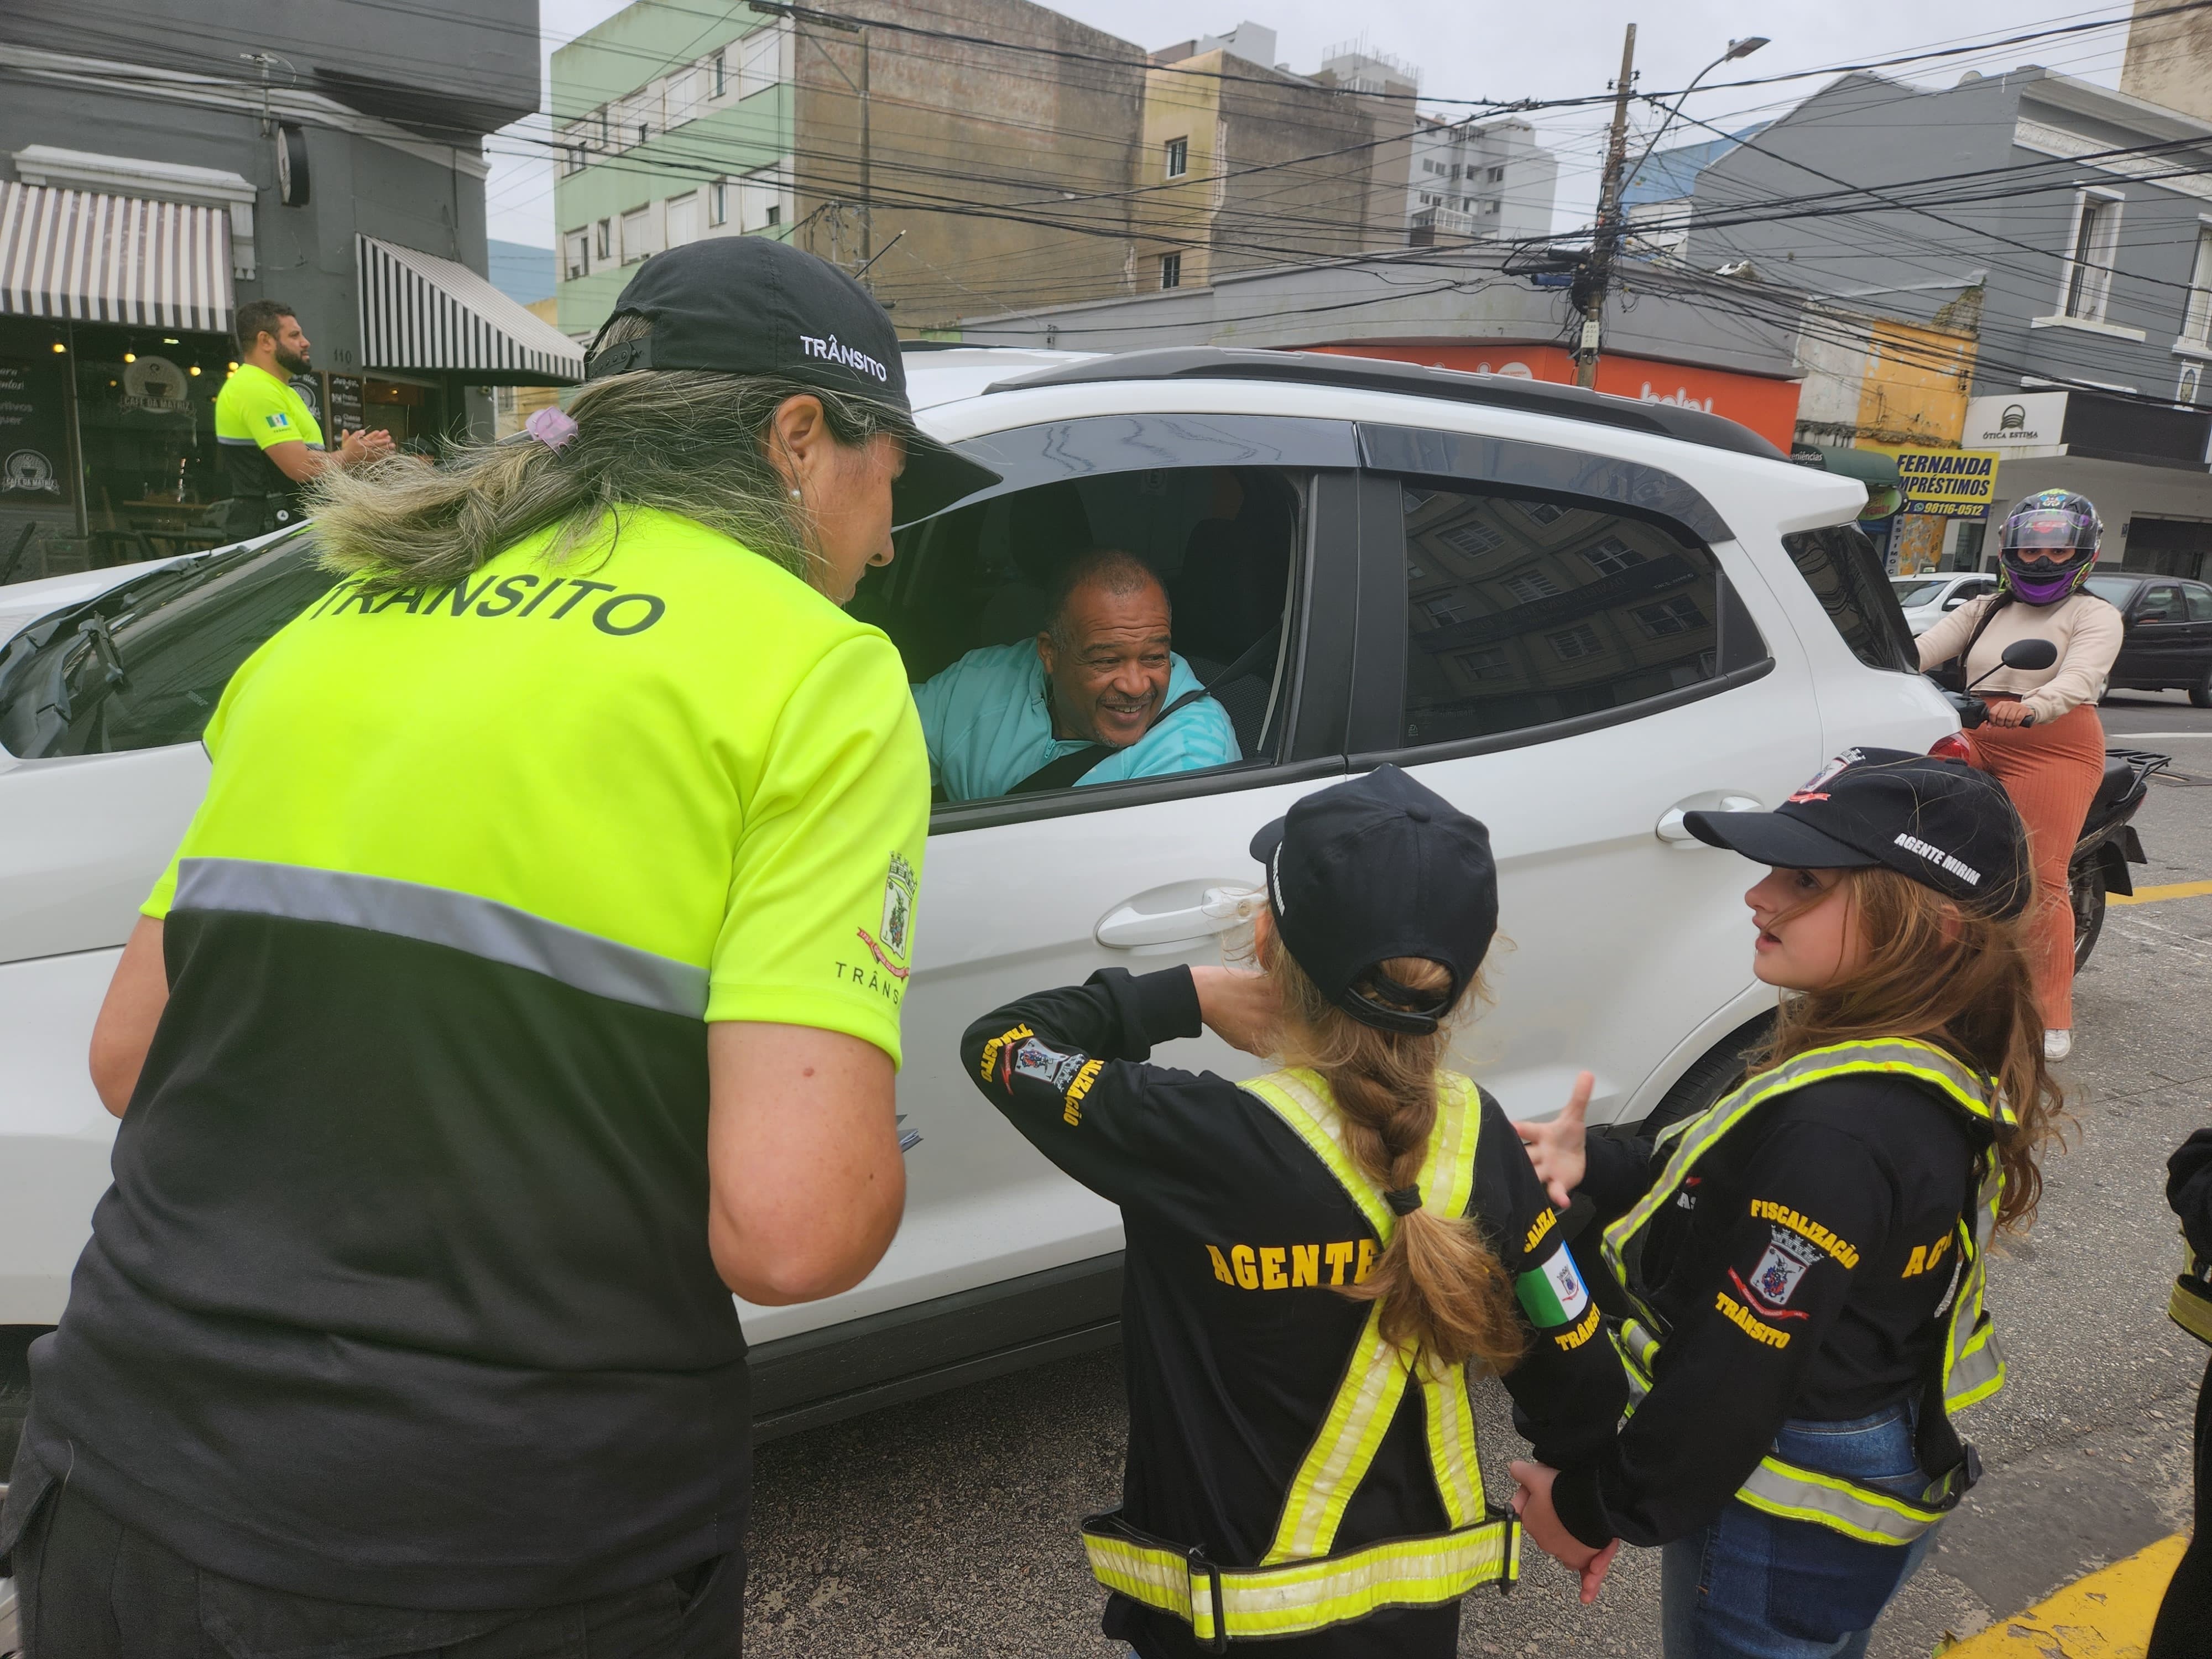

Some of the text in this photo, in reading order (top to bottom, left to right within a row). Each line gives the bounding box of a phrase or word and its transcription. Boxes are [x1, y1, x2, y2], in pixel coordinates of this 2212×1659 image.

[333, 346, 352, 363] 110
[800, 334, 887, 382] TRÂNSITO
[1791, 451, 1823, 461] eniências
[1897, 455, 1992, 476] FERNANDA
[1899, 474, 1990, 496] MPRÉSTIMOS
[1924, 502, 1984, 516] 98116-0512
[1893, 832, 1981, 885] AGENTE MIRIM
[1750, 1199, 1860, 1270] FISCALIZAÇÃO
[1206, 1239, 1379, 1291] AGENTE
[1554, 1301, 1601, 1352] TRÂNSI
[1715, 1291, 1791, 1349] TRÂNSITO
